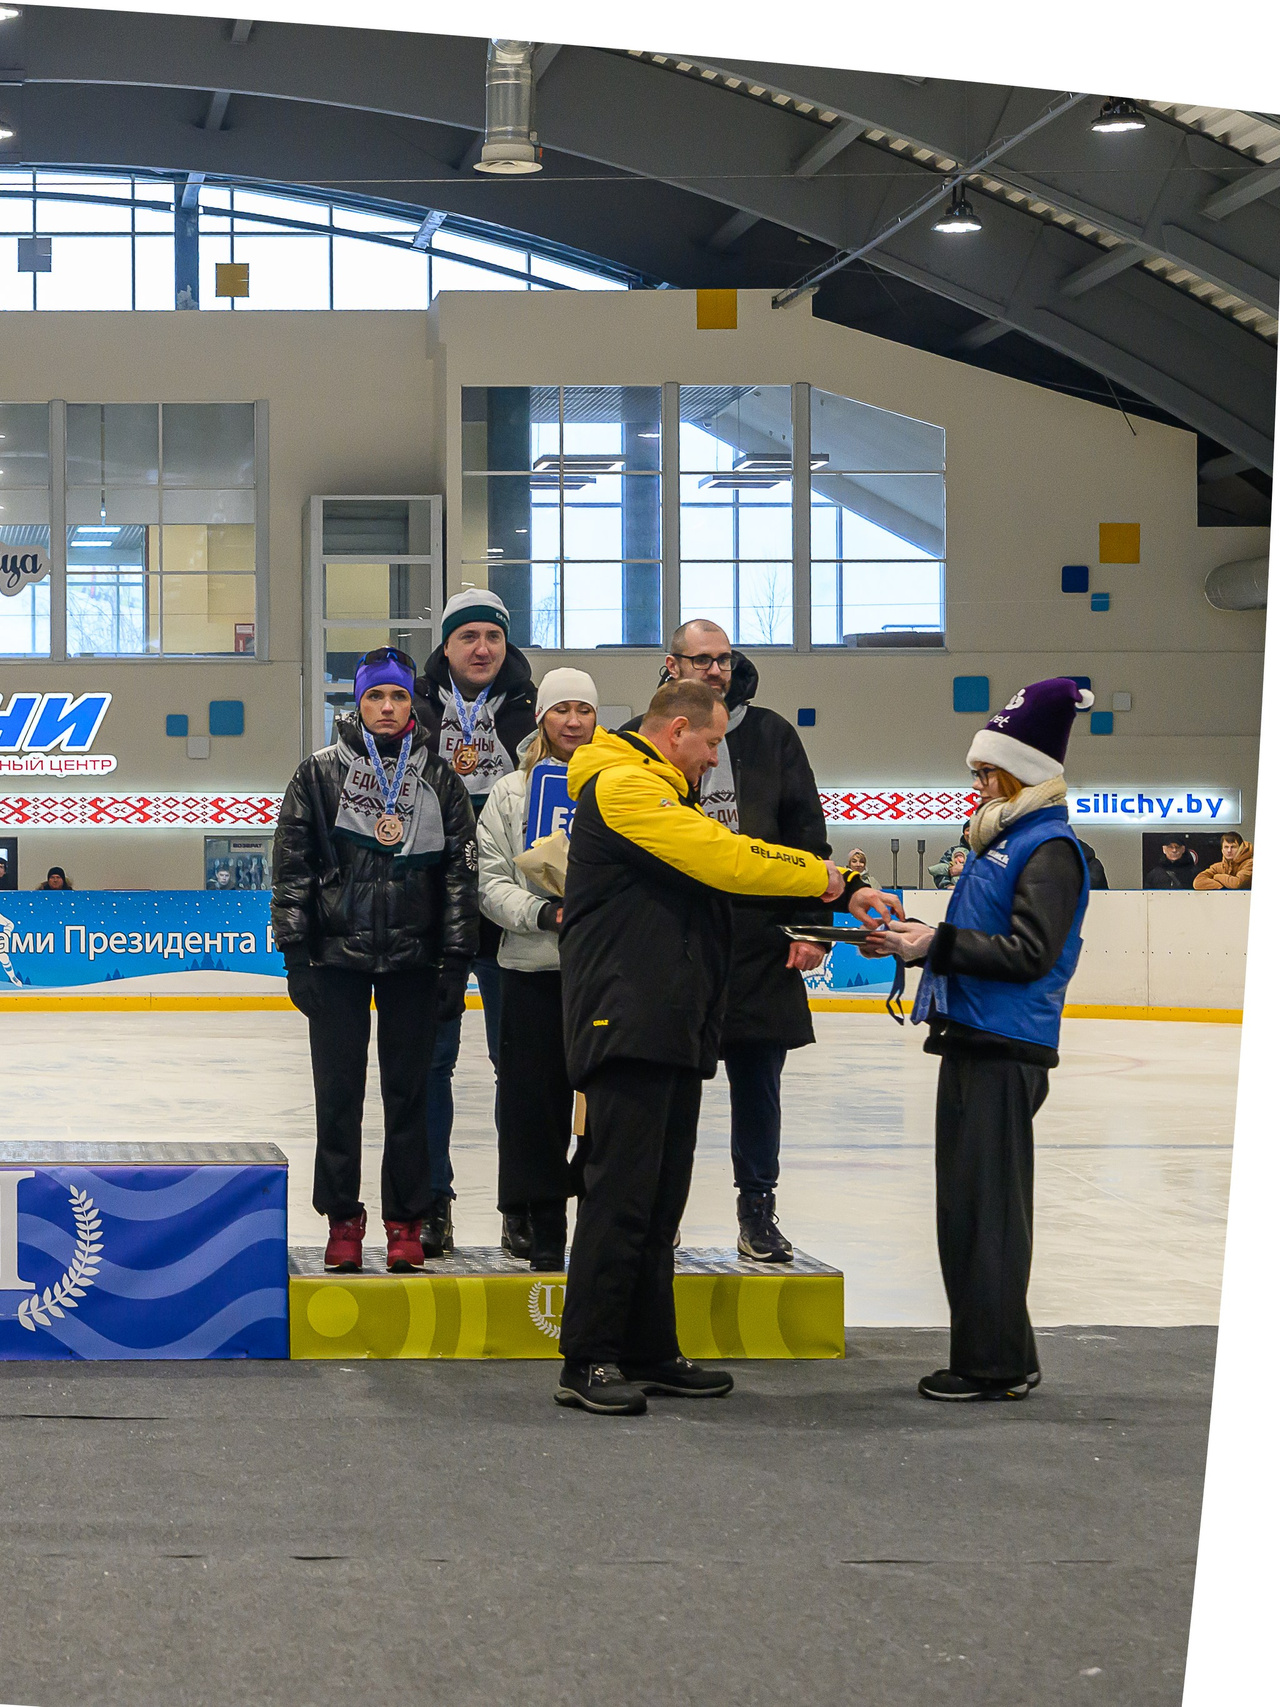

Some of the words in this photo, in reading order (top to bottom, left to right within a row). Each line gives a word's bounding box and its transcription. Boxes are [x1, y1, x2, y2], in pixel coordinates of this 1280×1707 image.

[49, 759, 113, 774] ЦЕНТР
[1076, 793, 1224, 818] silichy.by
[750, 845, 806, 868] BELARUS
[64, 925, 257, 961] Президента
